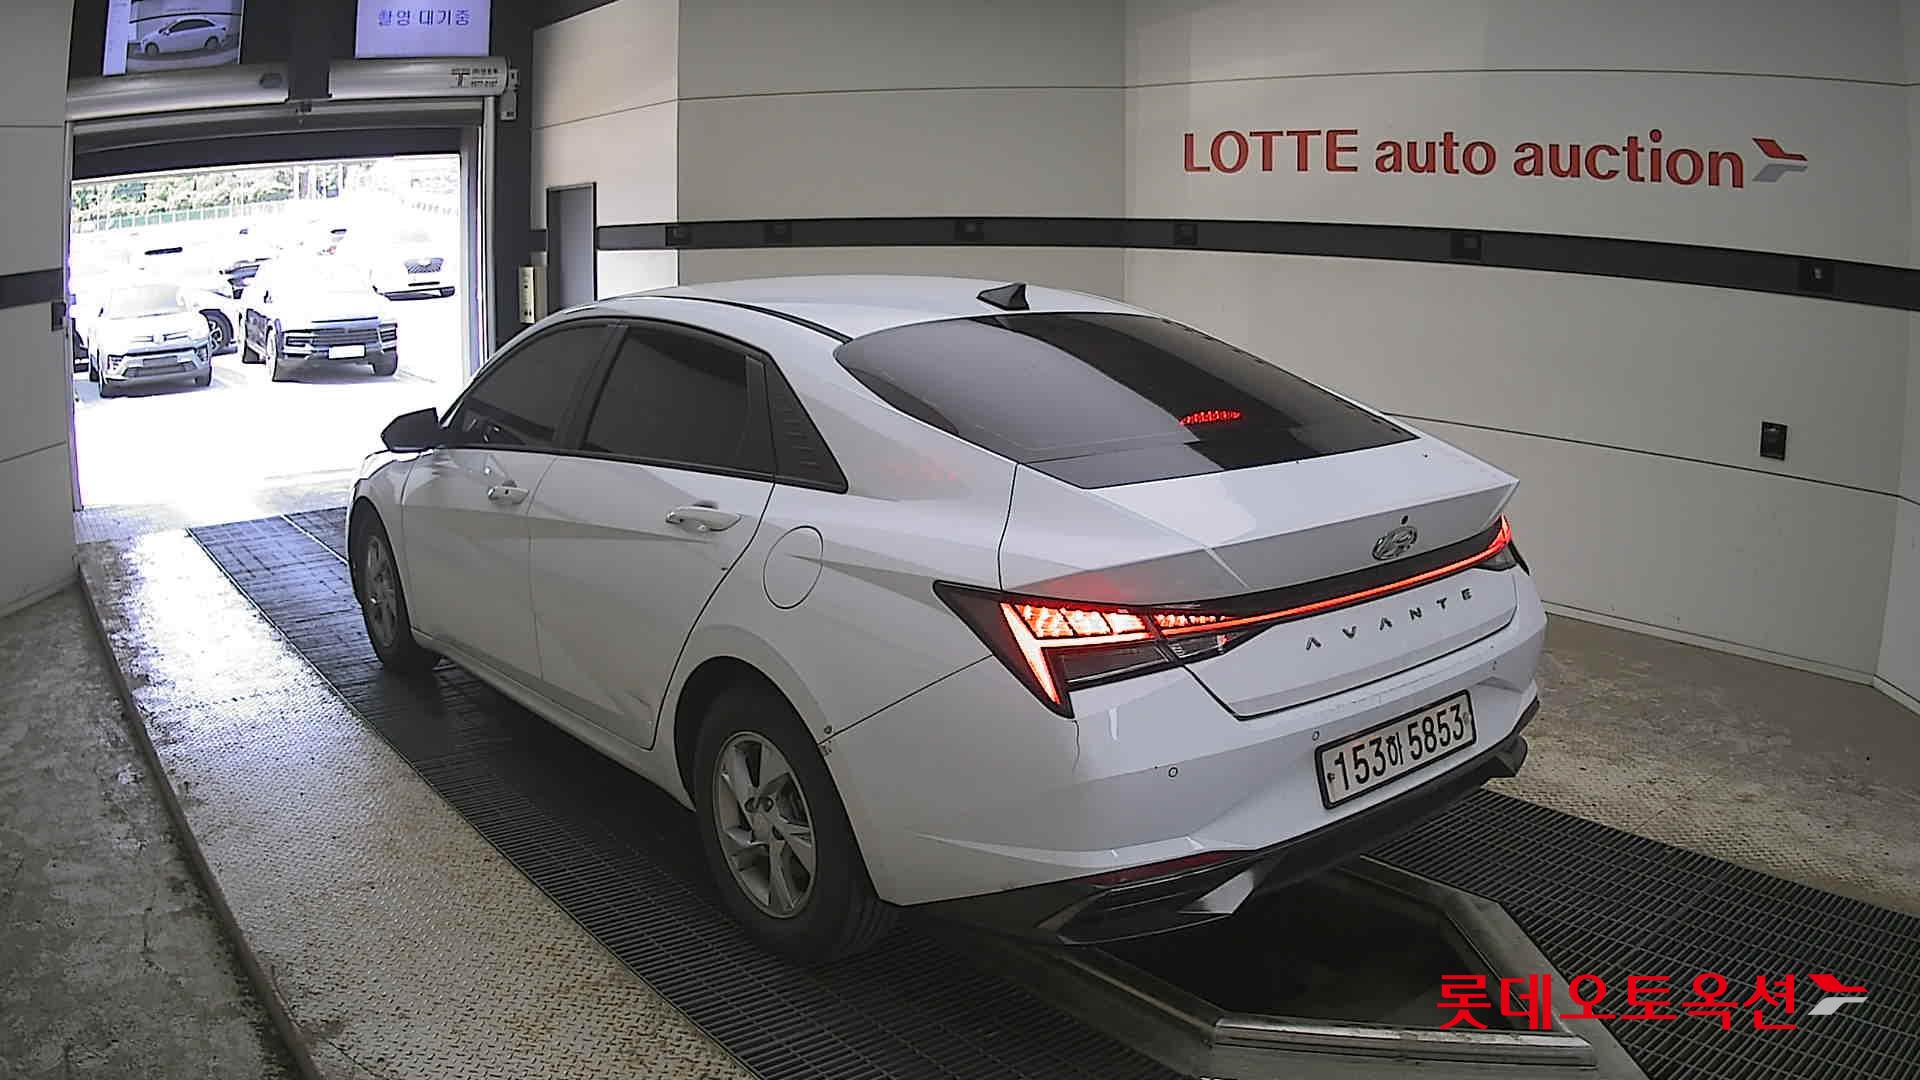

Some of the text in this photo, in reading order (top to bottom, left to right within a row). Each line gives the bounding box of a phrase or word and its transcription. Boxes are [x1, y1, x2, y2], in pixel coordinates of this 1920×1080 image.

[419, 9, 470, 26] 대기중
[1184, 129, 1744, 187] LOTTE auto auction
[1306, 588, 1473, 650] AVANTE
[1335, 705, 1465, 790] 153하 5853
